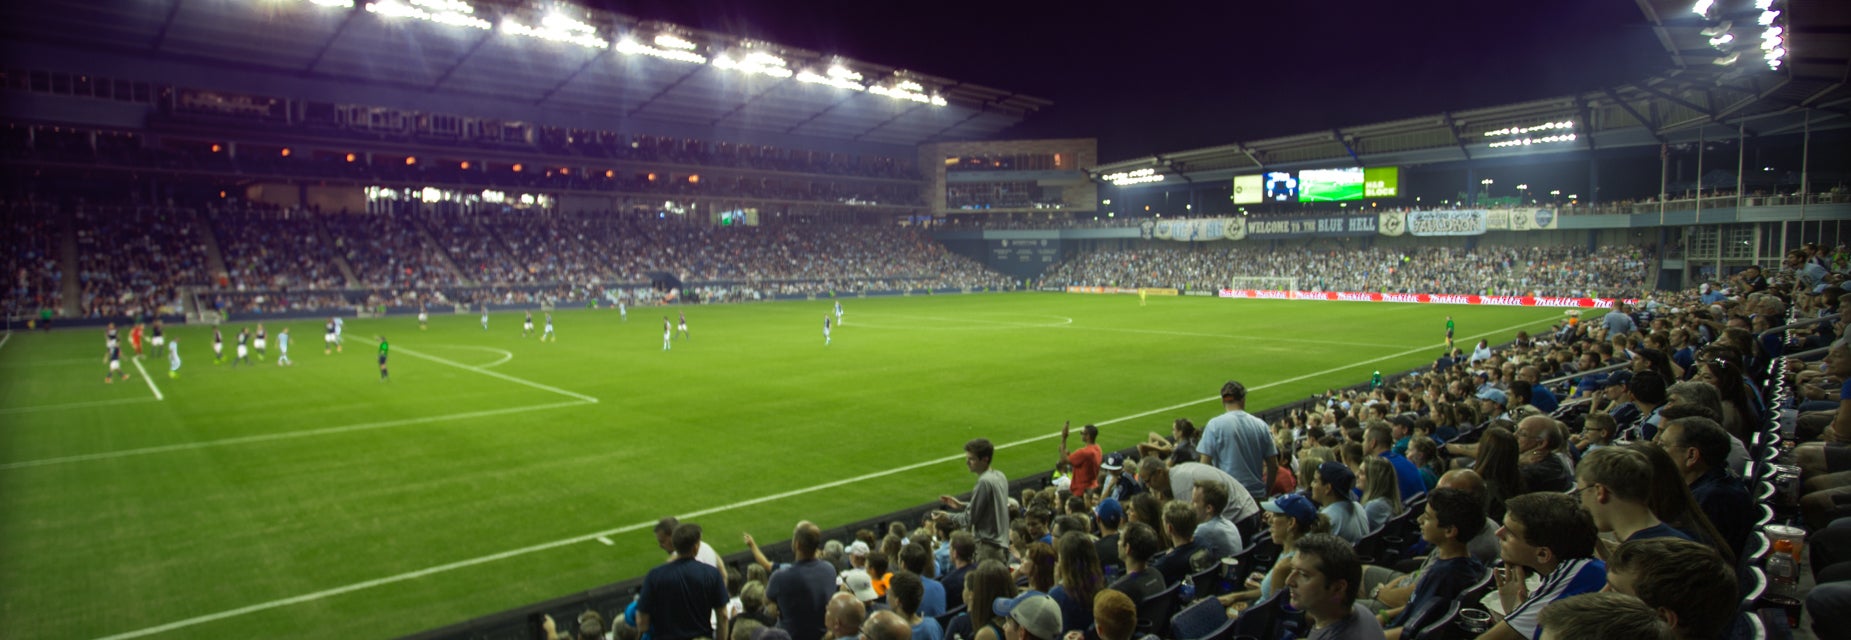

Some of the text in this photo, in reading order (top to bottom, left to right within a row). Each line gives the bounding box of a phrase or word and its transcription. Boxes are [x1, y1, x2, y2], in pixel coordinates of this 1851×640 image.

[1365, 181, 1384, 189] H&R
[1365, 188, 1395, 196] BLOCK
[1248, 217, 1375, 234] WELCOME TO THE BLUE HELL
